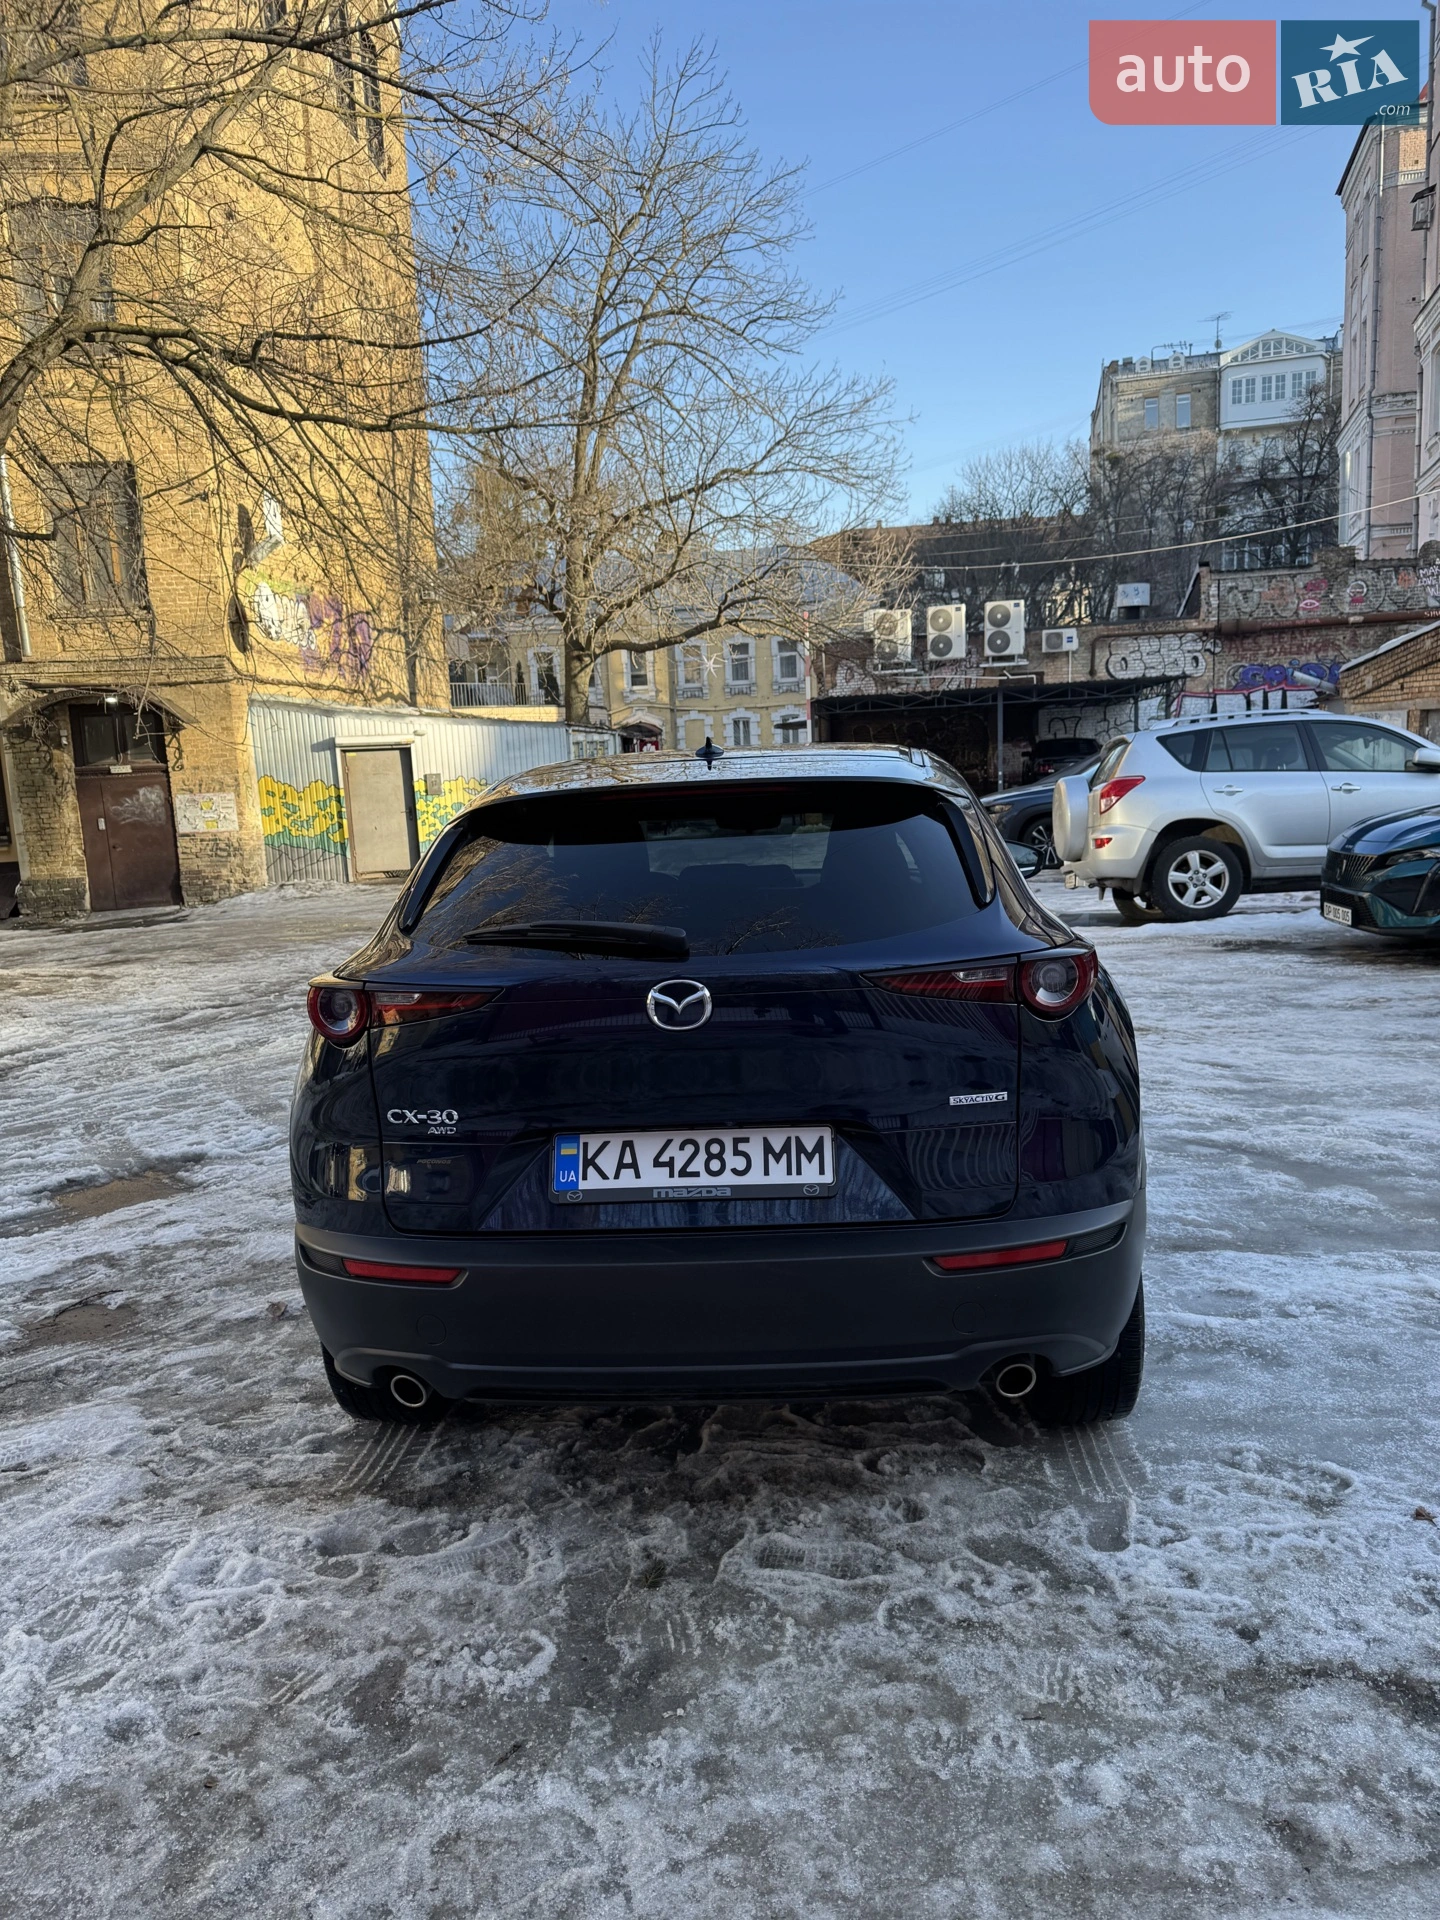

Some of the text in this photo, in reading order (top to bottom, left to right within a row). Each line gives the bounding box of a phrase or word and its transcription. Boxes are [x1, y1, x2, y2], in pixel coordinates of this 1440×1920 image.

[387, 1109, 459, 1125] CX-30
[427, 1126, 456, 1135] AWD
[582, 1135, 825, 1181] KA 4285 MM
[559, 1170, 577, 1183] UA
